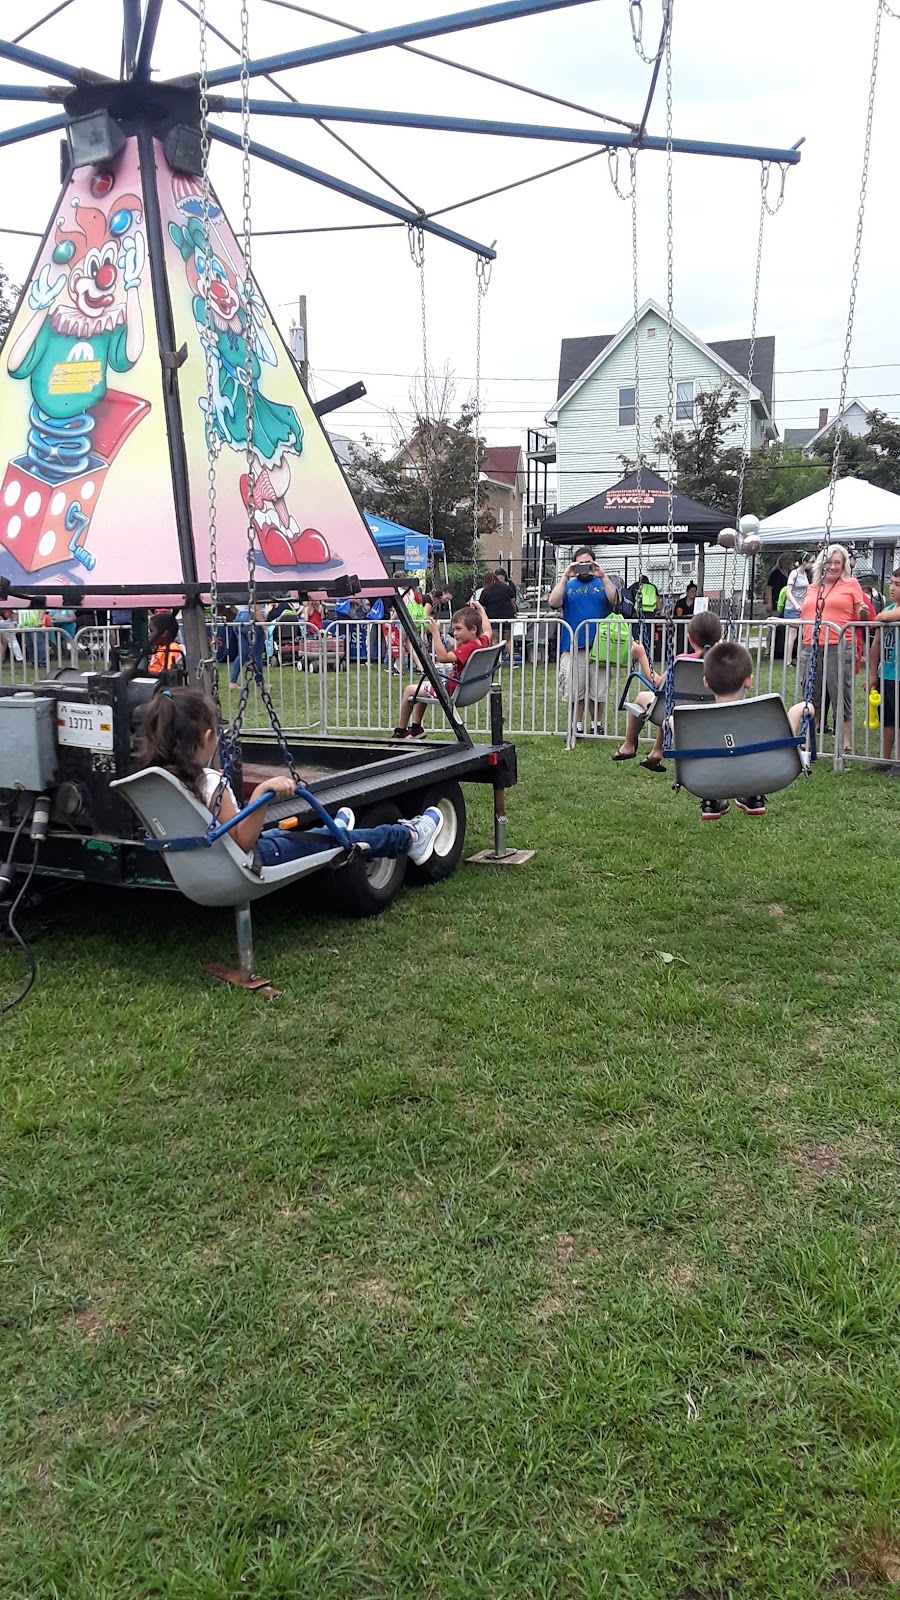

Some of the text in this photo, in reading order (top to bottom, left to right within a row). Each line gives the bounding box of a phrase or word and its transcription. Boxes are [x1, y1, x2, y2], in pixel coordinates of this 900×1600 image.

[605, 496, 655, 506] ywca
[616, 525, 626, 533] IS
[626, 525, 640, 533] ON
[640, 525, 649, 533] A
[69, 716, 94, 731] 13771
[725, 735, 733, 747] 8
